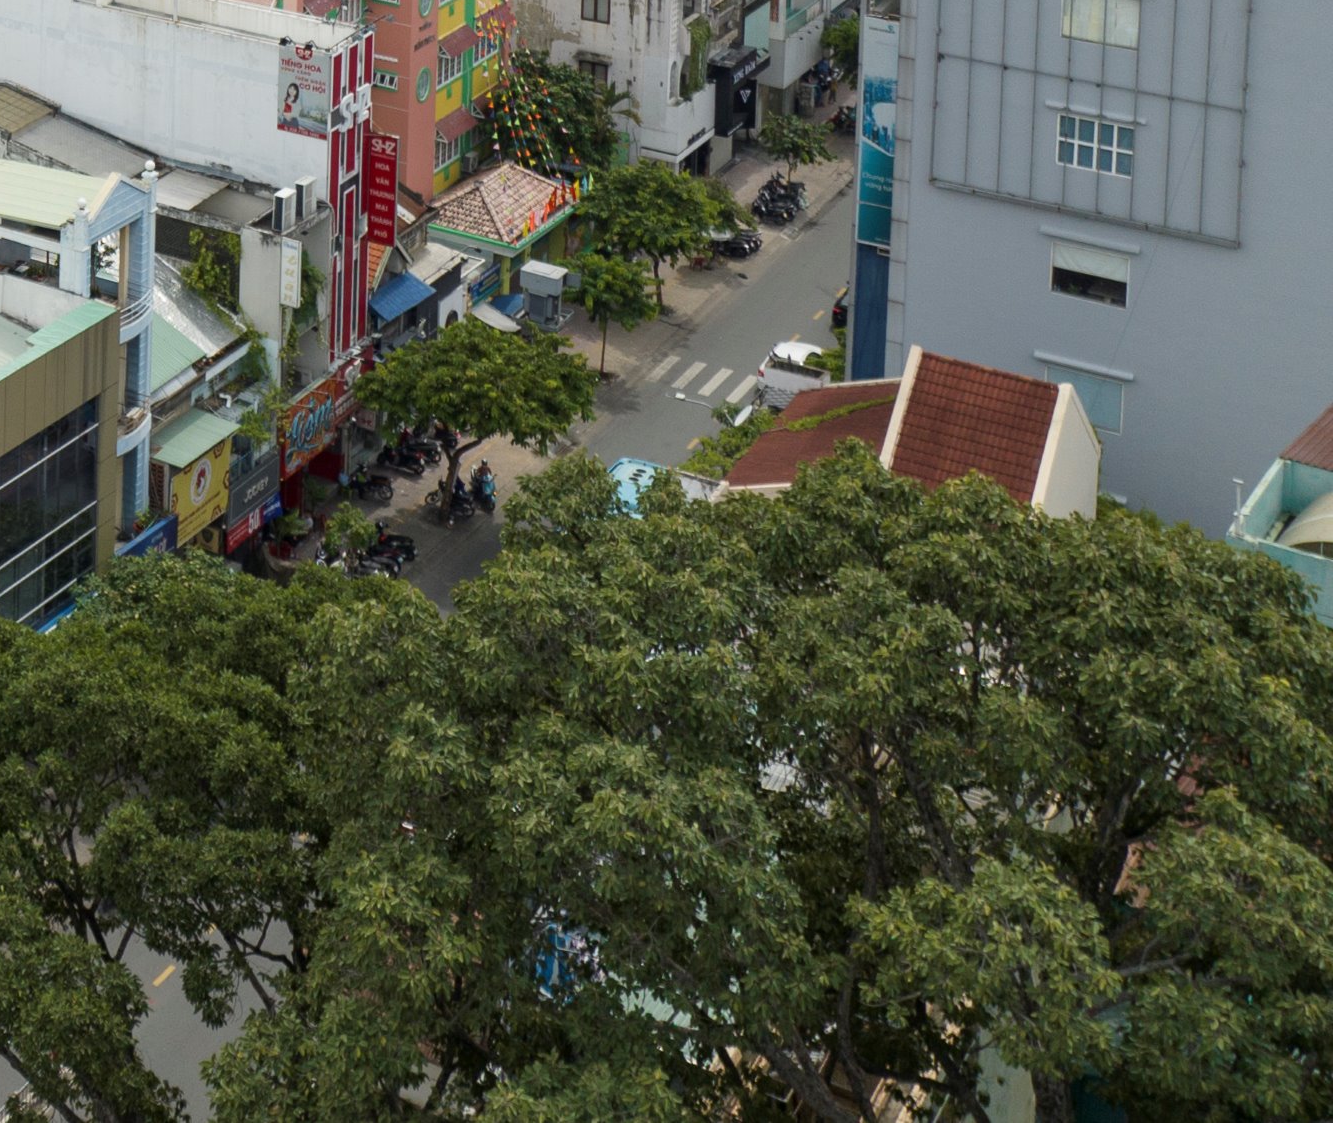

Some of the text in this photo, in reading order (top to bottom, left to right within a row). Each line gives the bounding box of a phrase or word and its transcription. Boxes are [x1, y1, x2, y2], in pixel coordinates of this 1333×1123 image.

[305, 64, 322, 74] HOA
[371, 138, 396, 156] SHZ
[375, 161, 390, 172] HOA
